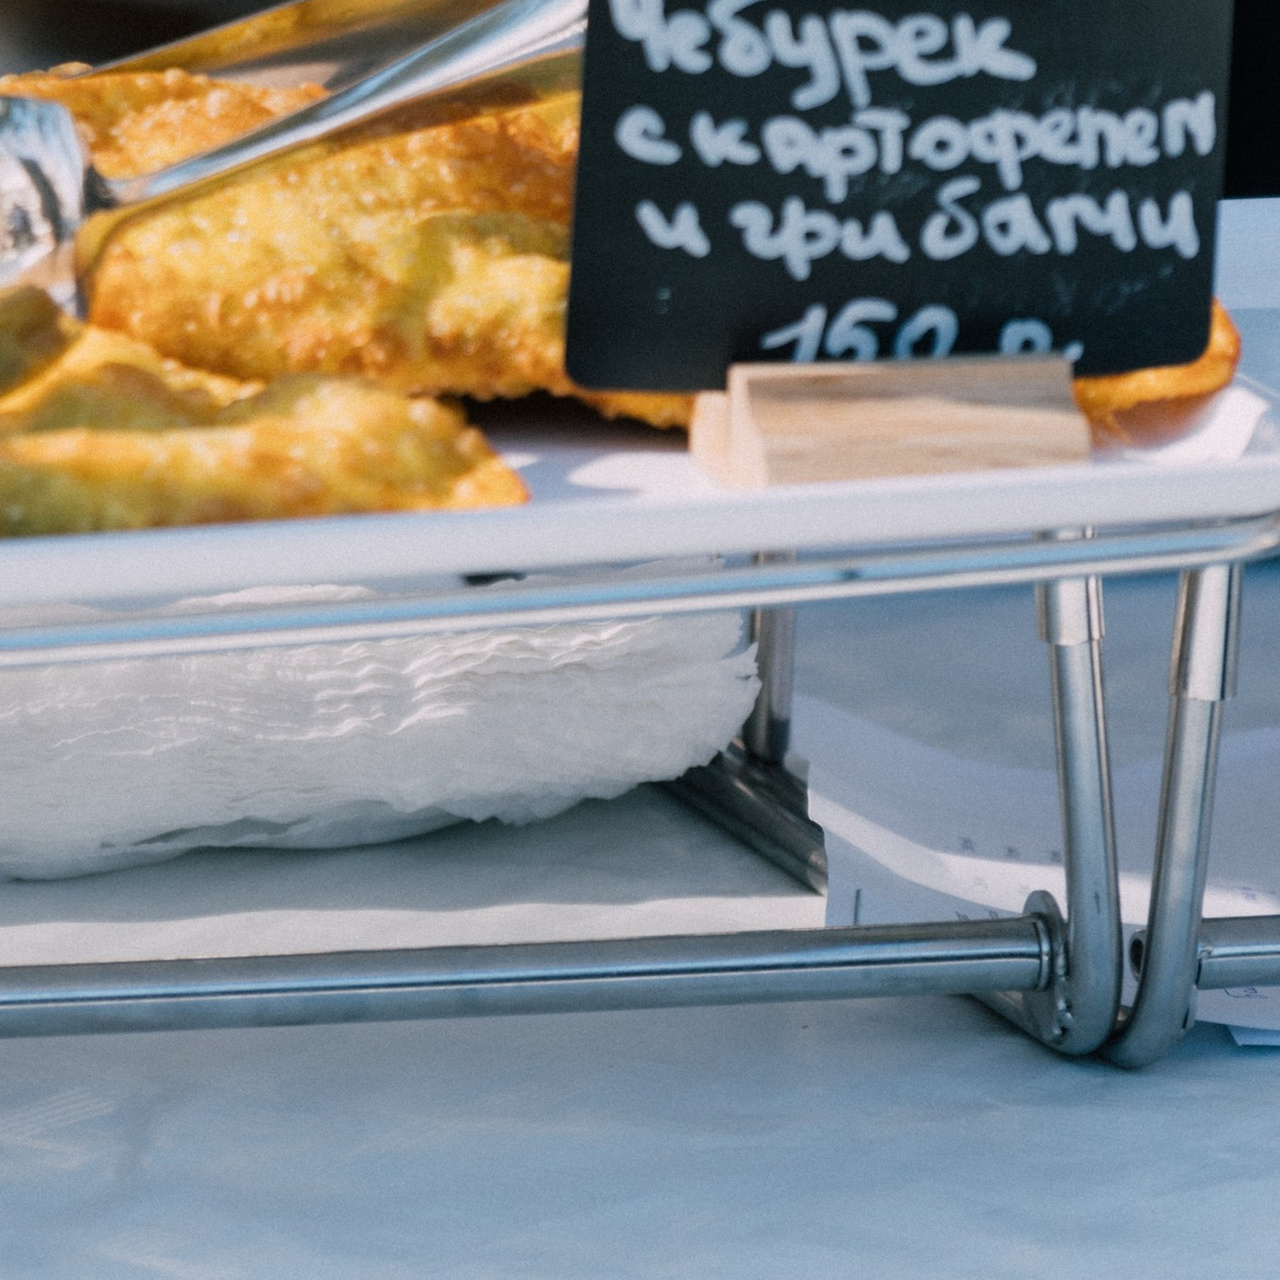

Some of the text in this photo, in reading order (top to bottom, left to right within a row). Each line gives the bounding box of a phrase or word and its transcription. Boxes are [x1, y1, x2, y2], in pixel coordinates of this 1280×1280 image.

[690, 89, 1216, 204] картофелем
[635, 173, 1199, 281] и грибами
